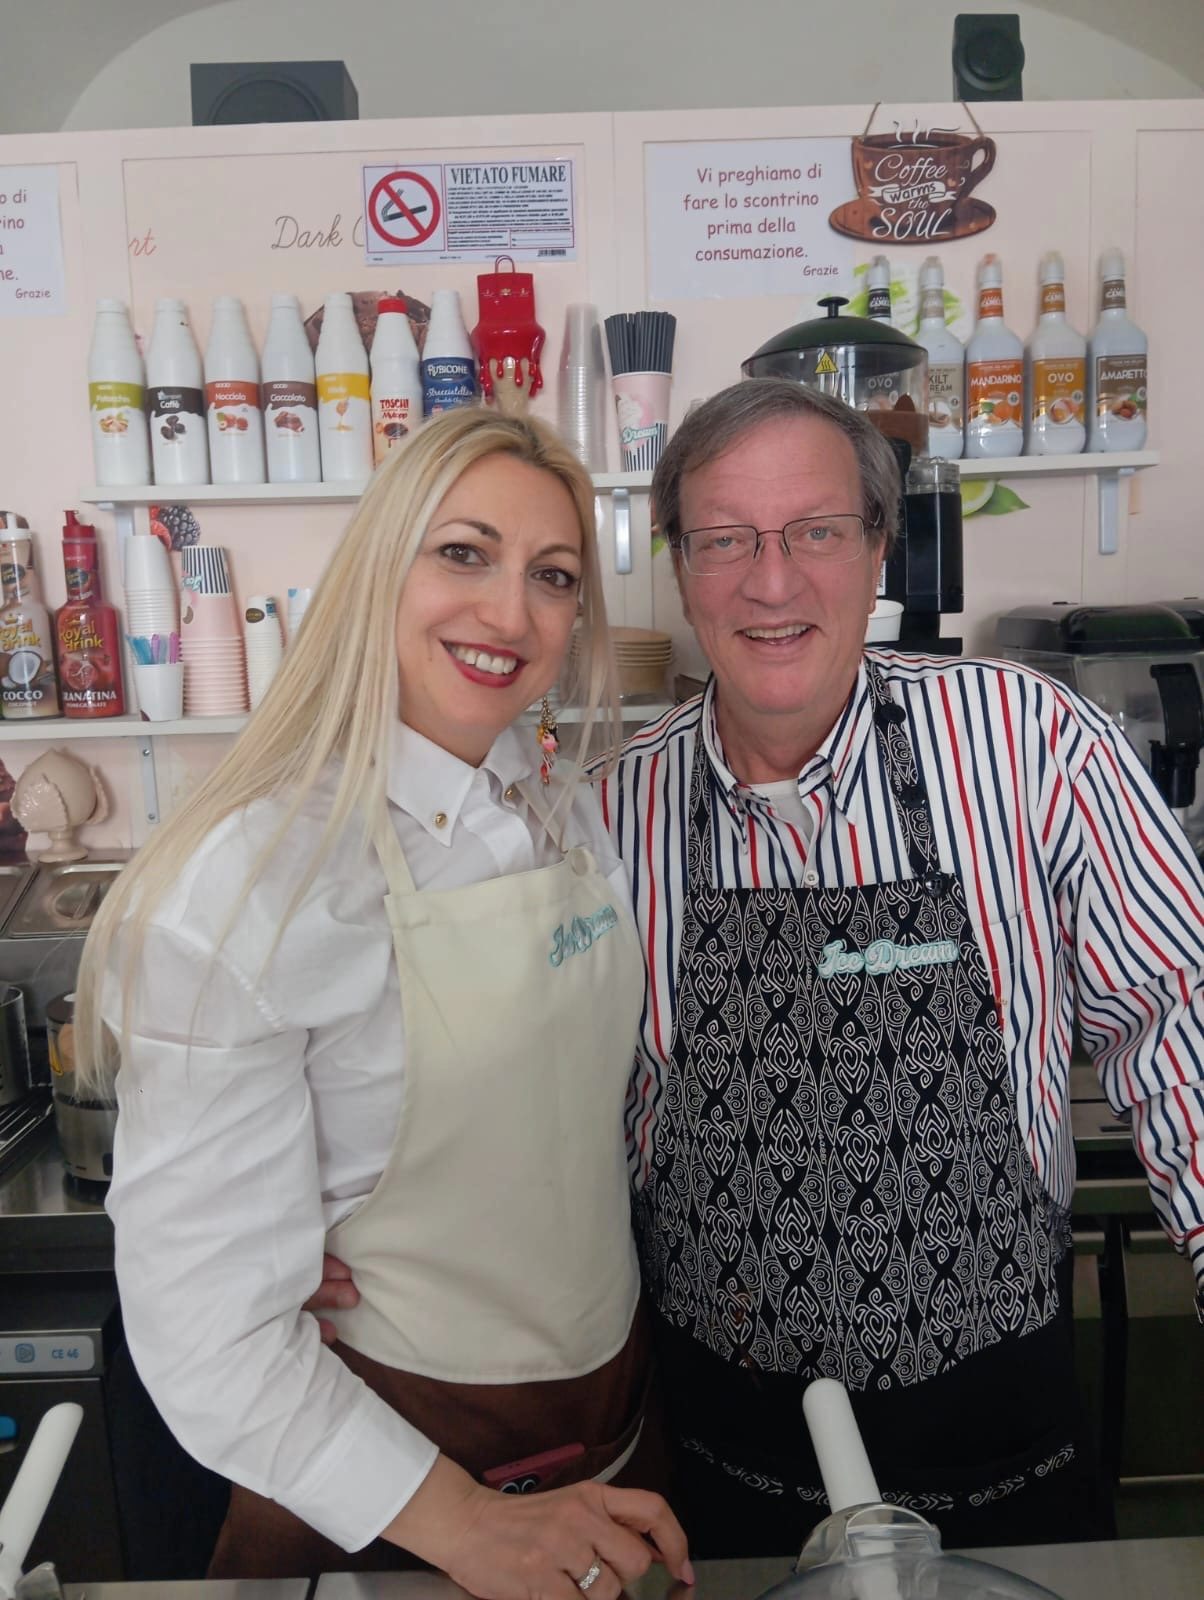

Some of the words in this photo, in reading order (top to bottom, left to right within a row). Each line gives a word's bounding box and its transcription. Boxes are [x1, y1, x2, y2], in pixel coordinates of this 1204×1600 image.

[450, 166, 509, 185] VIETATO
[511, 165, 567, 184] FUMARE
[697, 168, 713, 184] Vi
[718, 164, 801, 186] preghiamo
[807, 164, 822, 180] di
[874, 153, 948, 187] Coffee
[12, 188, 27, 204] di
[889, 182, 937, 203] warms
[683, 196, 720, 211] fare
[725, 195, 738, 209] lo
[743, 192, 819, 209] scontrino
[0, 216, 25, 230] ino
[707, 220, 753, 239] prima
[758, 217, 796, 234] della
[872, 207, 952, 240] SOUL
[270, 213, 344, 250] Dark
[695, 245, 809, 262] consumazione.
[803, 264, 839, 277] Grazie
[15, 288, 51, 299] Grazie
[427, 364, 469, 377] RUBICONE
[1047, 372, 1075, 384] OVO
[867, 376, 893, 390] OVO
[970, 373, 1022, 386] MANDARINO
[929, 384, 953, 393] REAM
[65, 634, 105, 653] drink
[3, 690, 43, 700] COCCO
[63, 690, 117, 701] RANATINA
[818, 938, 865, 979] Ice
[865, 938, 959, 976] Dream
